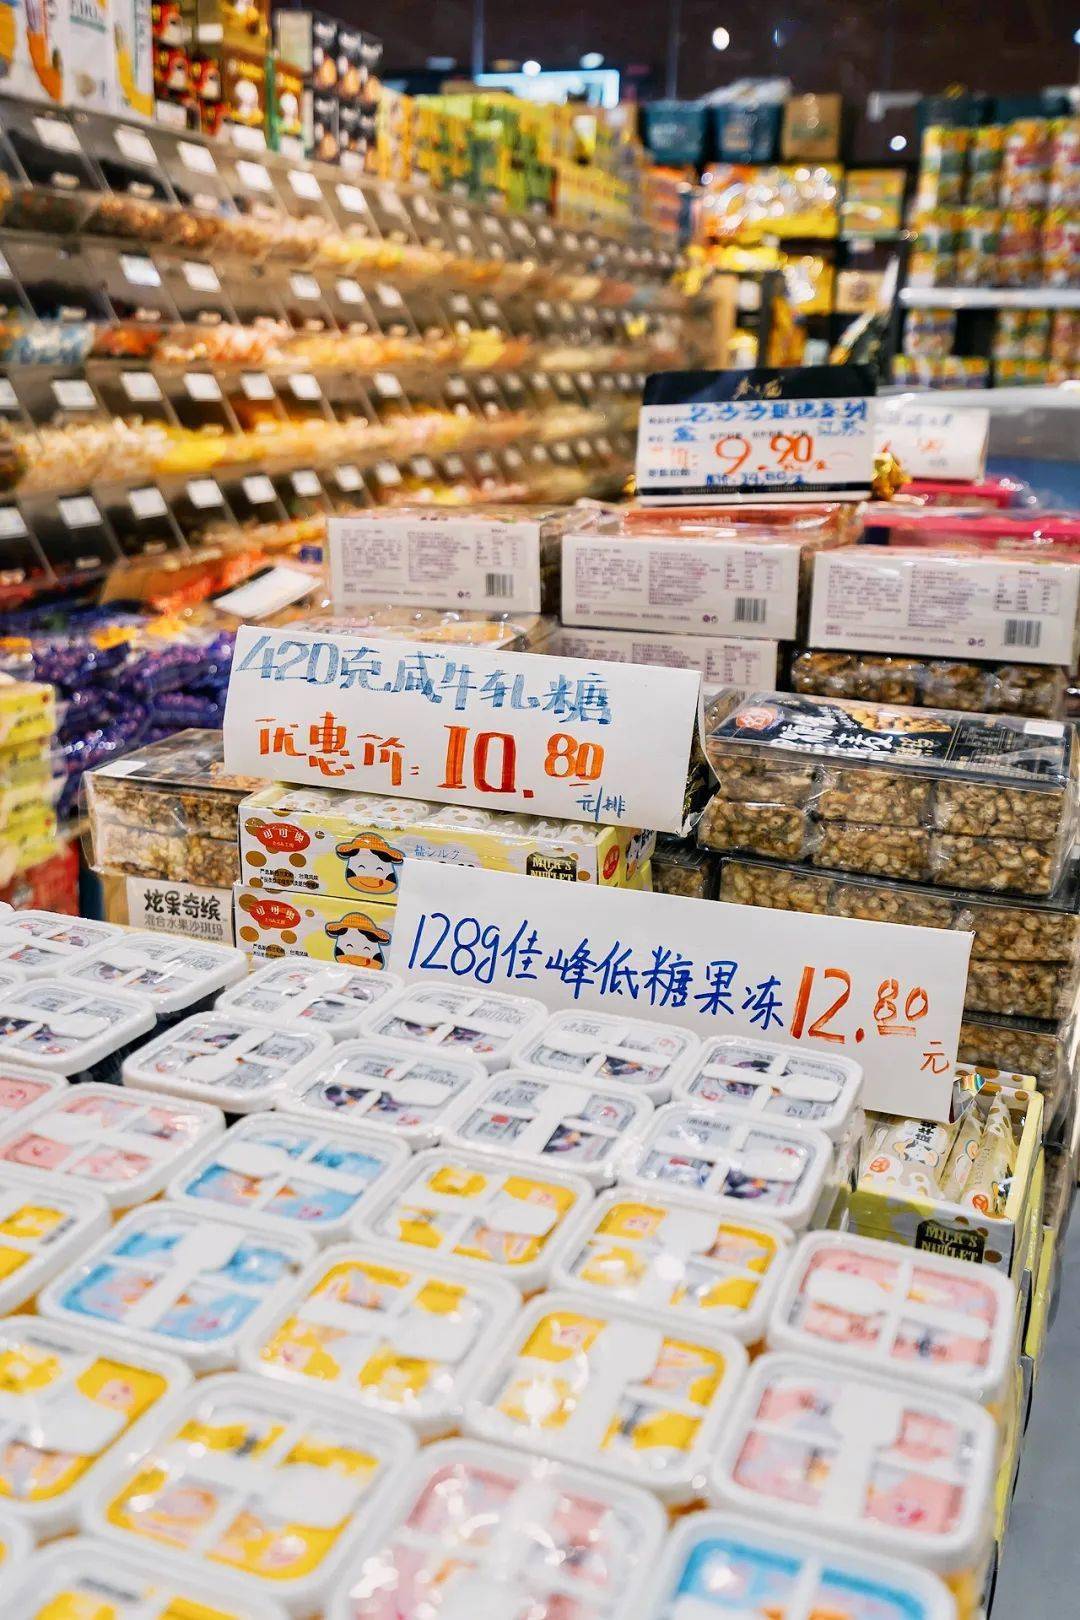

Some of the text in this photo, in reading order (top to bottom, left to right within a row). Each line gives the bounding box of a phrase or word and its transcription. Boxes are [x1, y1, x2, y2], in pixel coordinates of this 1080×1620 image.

[437, 725, 605, 798] 10.80
[790, 966, 929, 1044] 12.80
[920, 1041, 950, 1074] 元
